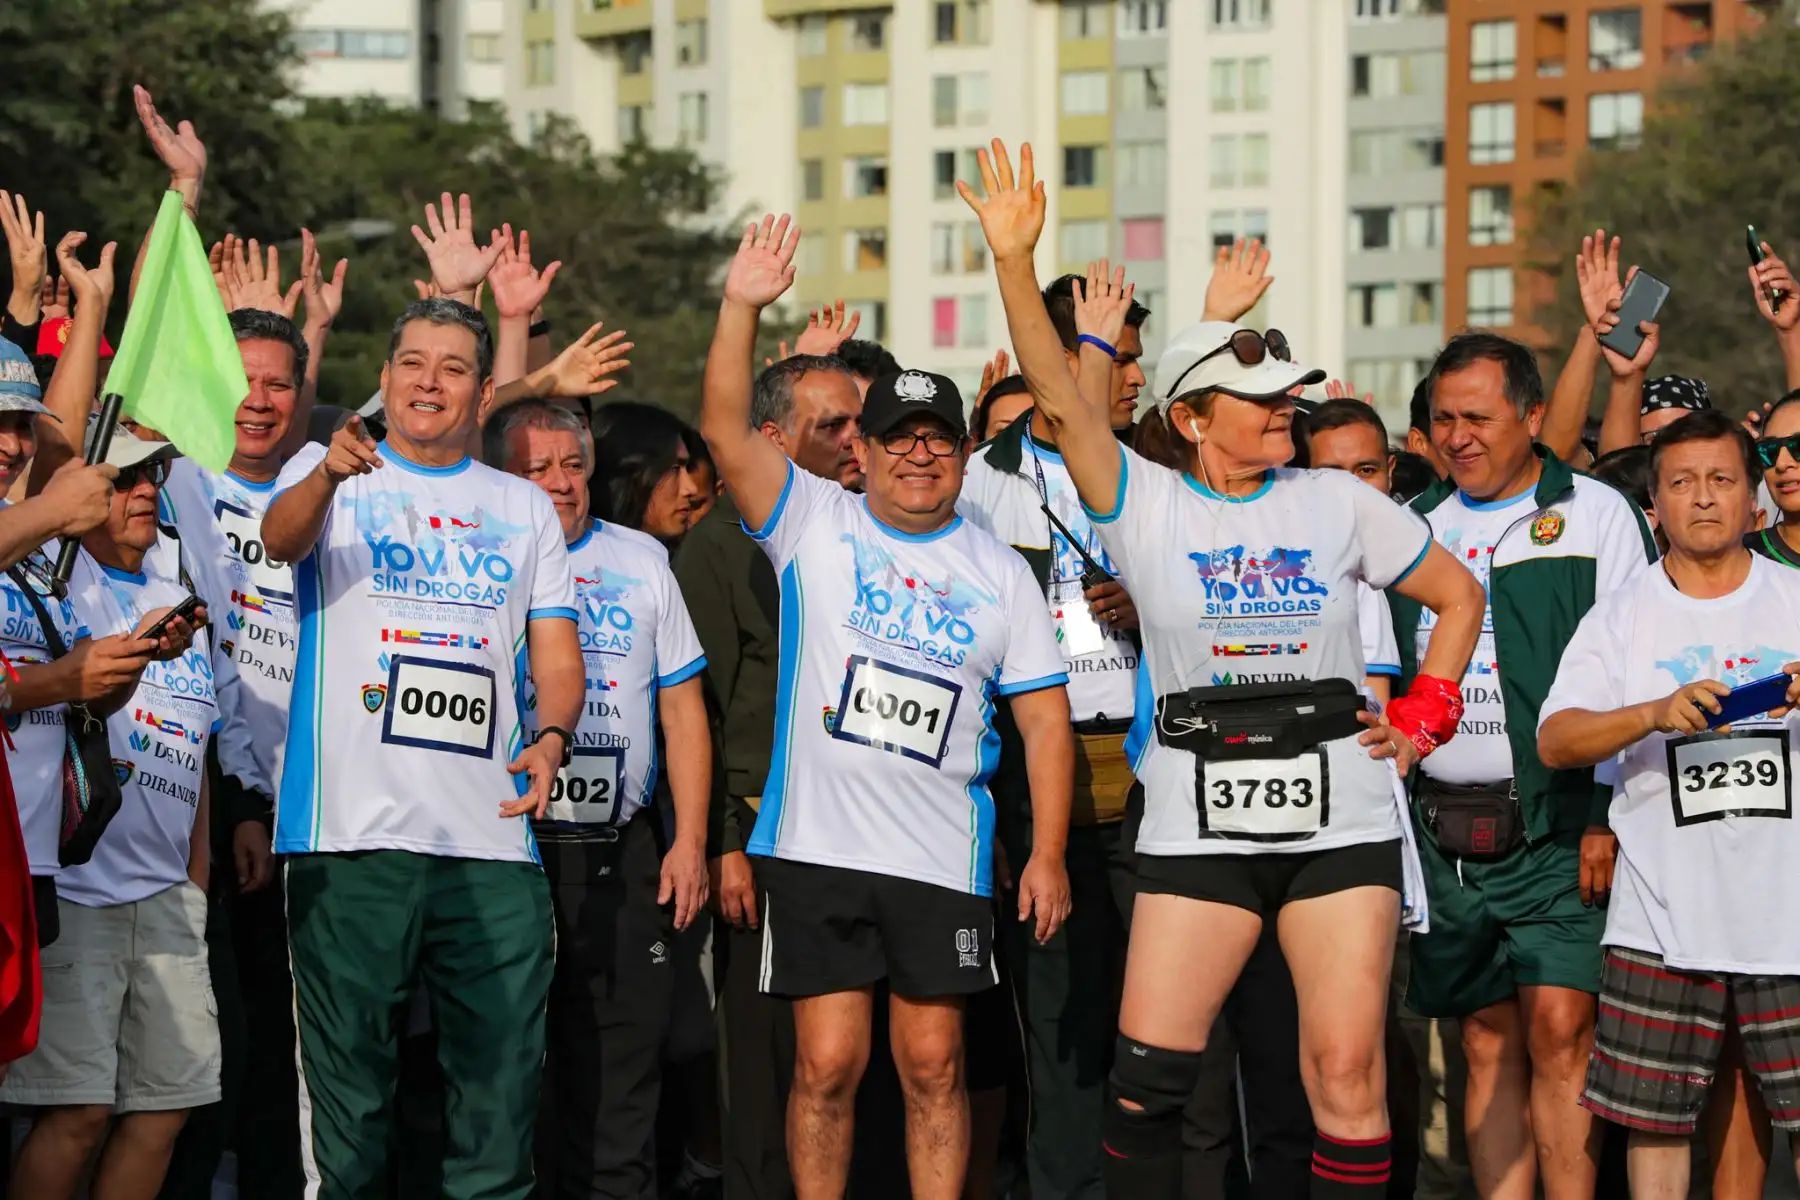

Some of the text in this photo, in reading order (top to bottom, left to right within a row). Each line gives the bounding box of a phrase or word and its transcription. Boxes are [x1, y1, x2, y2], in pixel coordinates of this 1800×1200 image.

[362, 530, 415, 572] YO
[373, 573, 507, 606] SIN DROGAS
[848, 609, 881, 635] SIN
[1206, 600, 1322, 615] SIN DROGAS
[4, 617, 34, 641] SIN
[1064, 656, 1136, 673] DIRAND
[29, 710, 64, 725] DIRA
[401, 687, 486, 725] 0006
[854, 687, 941, 734] 0001
[138, 771, 197, 808] DIRANDR
[548, 776, 611, 804] 002
[1684, 759, 1778, 793] 3239
[1211, 778, 1314, 809] 3783
[956, 928, 978, 952] 01
